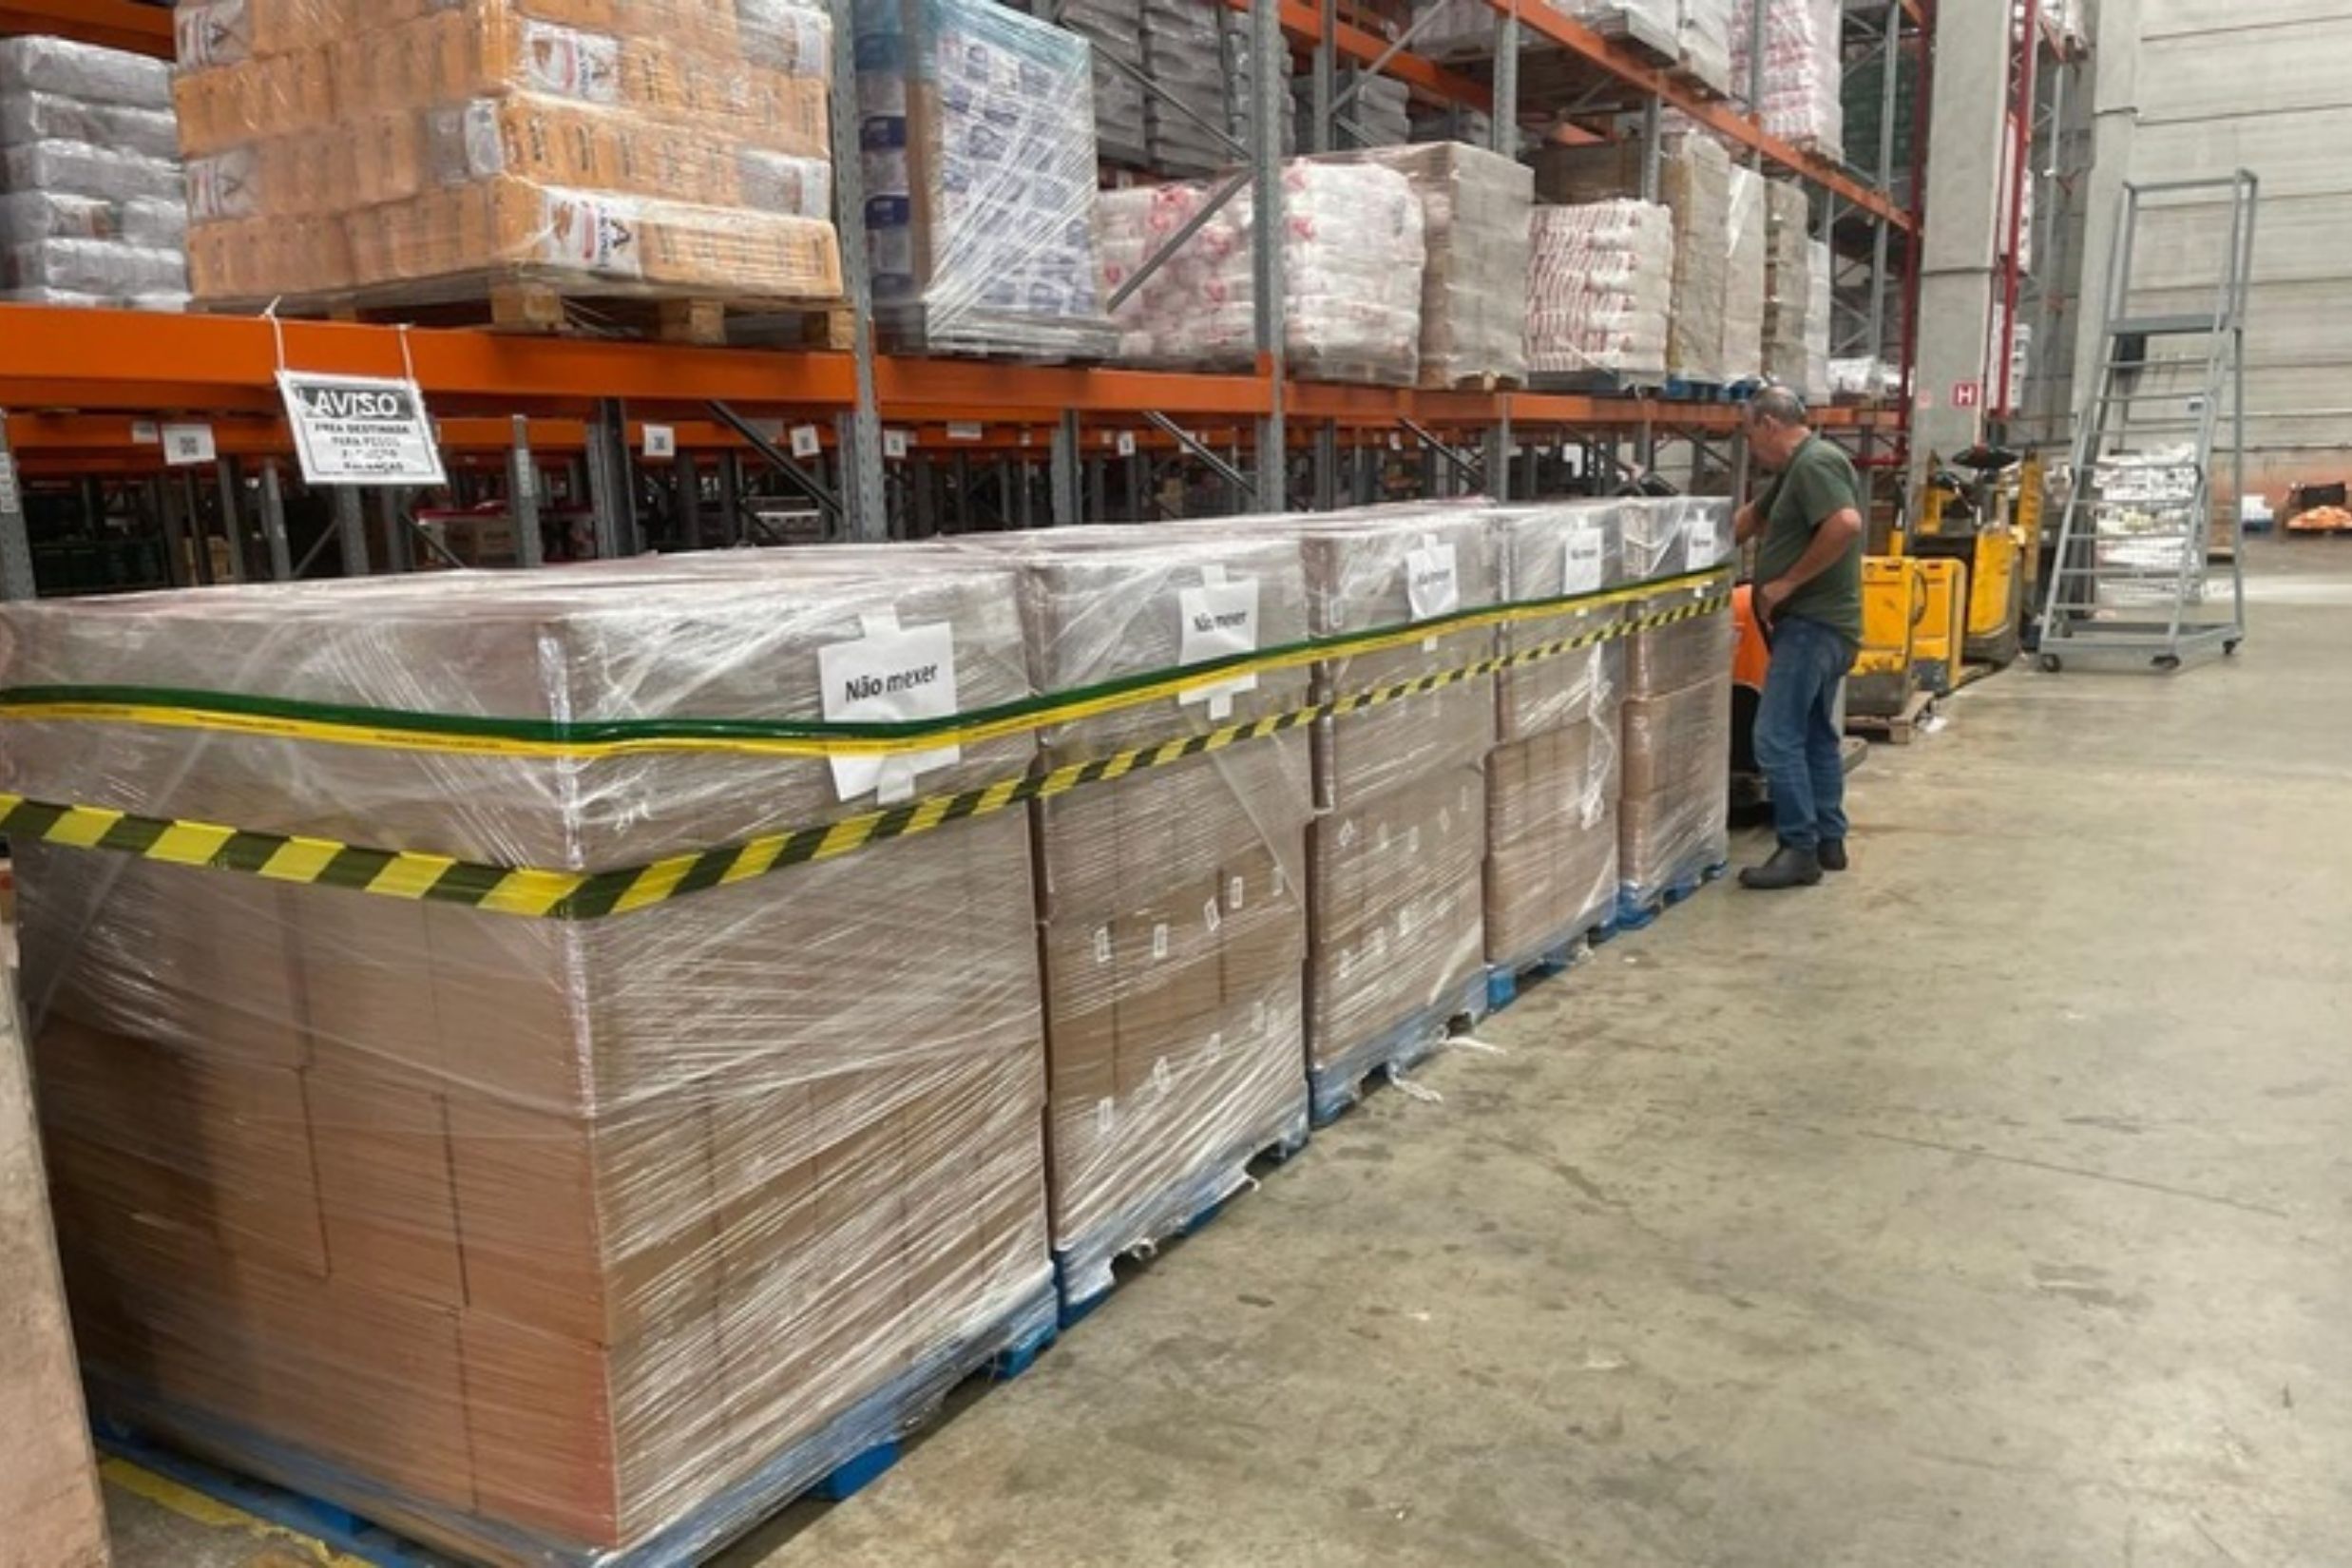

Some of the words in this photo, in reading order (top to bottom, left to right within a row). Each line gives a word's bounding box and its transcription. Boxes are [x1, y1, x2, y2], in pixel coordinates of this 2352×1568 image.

[315, 388, 399, 417] AVISO
[1958, 386, 1973, 405] H
[845, 675, 882, 704] Não
[886, 663, 938, 694] mexer
